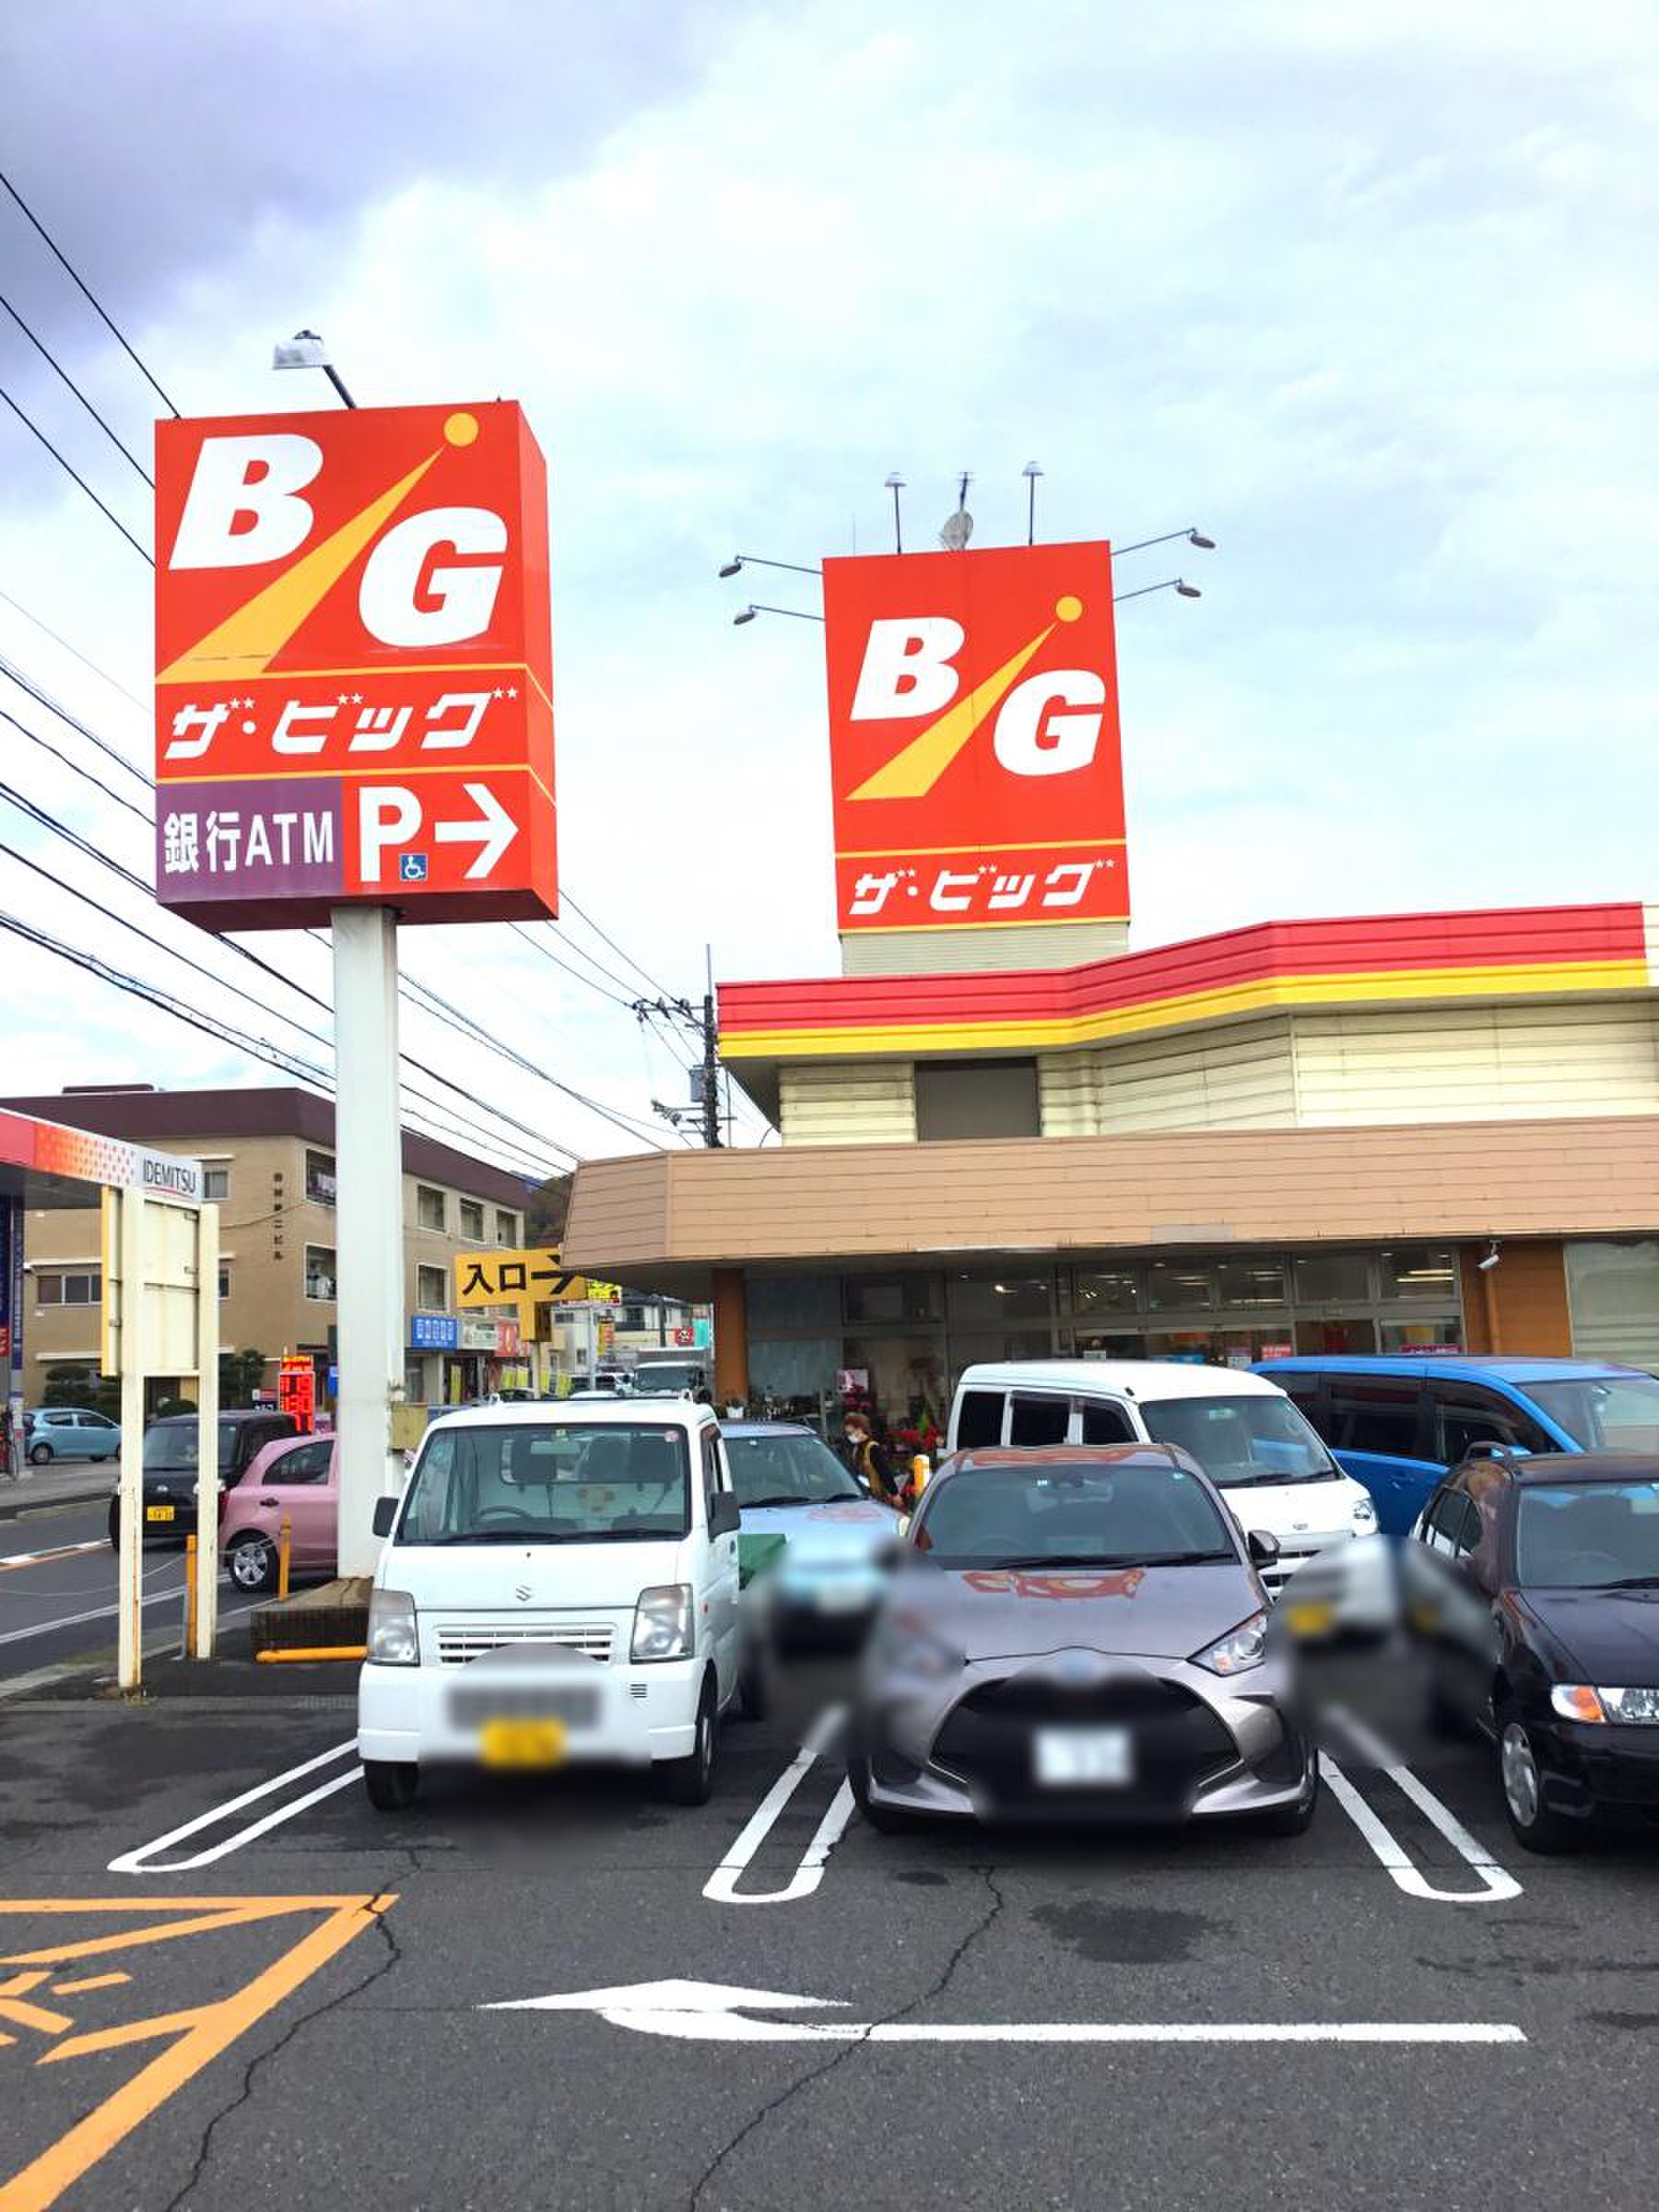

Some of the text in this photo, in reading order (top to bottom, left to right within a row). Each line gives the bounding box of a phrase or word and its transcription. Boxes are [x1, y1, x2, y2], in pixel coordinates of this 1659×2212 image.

[164, 687, 518, 760] ザ・ビッグ
[163, 810, 334, 875] 銀行ATM
[359, 785, 424, 883] P
[849, 859, 1115, 915] ザ・ビッグ
[143, 1159, 197, 1194] IDEMITSU
[462, 1263, 527, 1296] 入口
